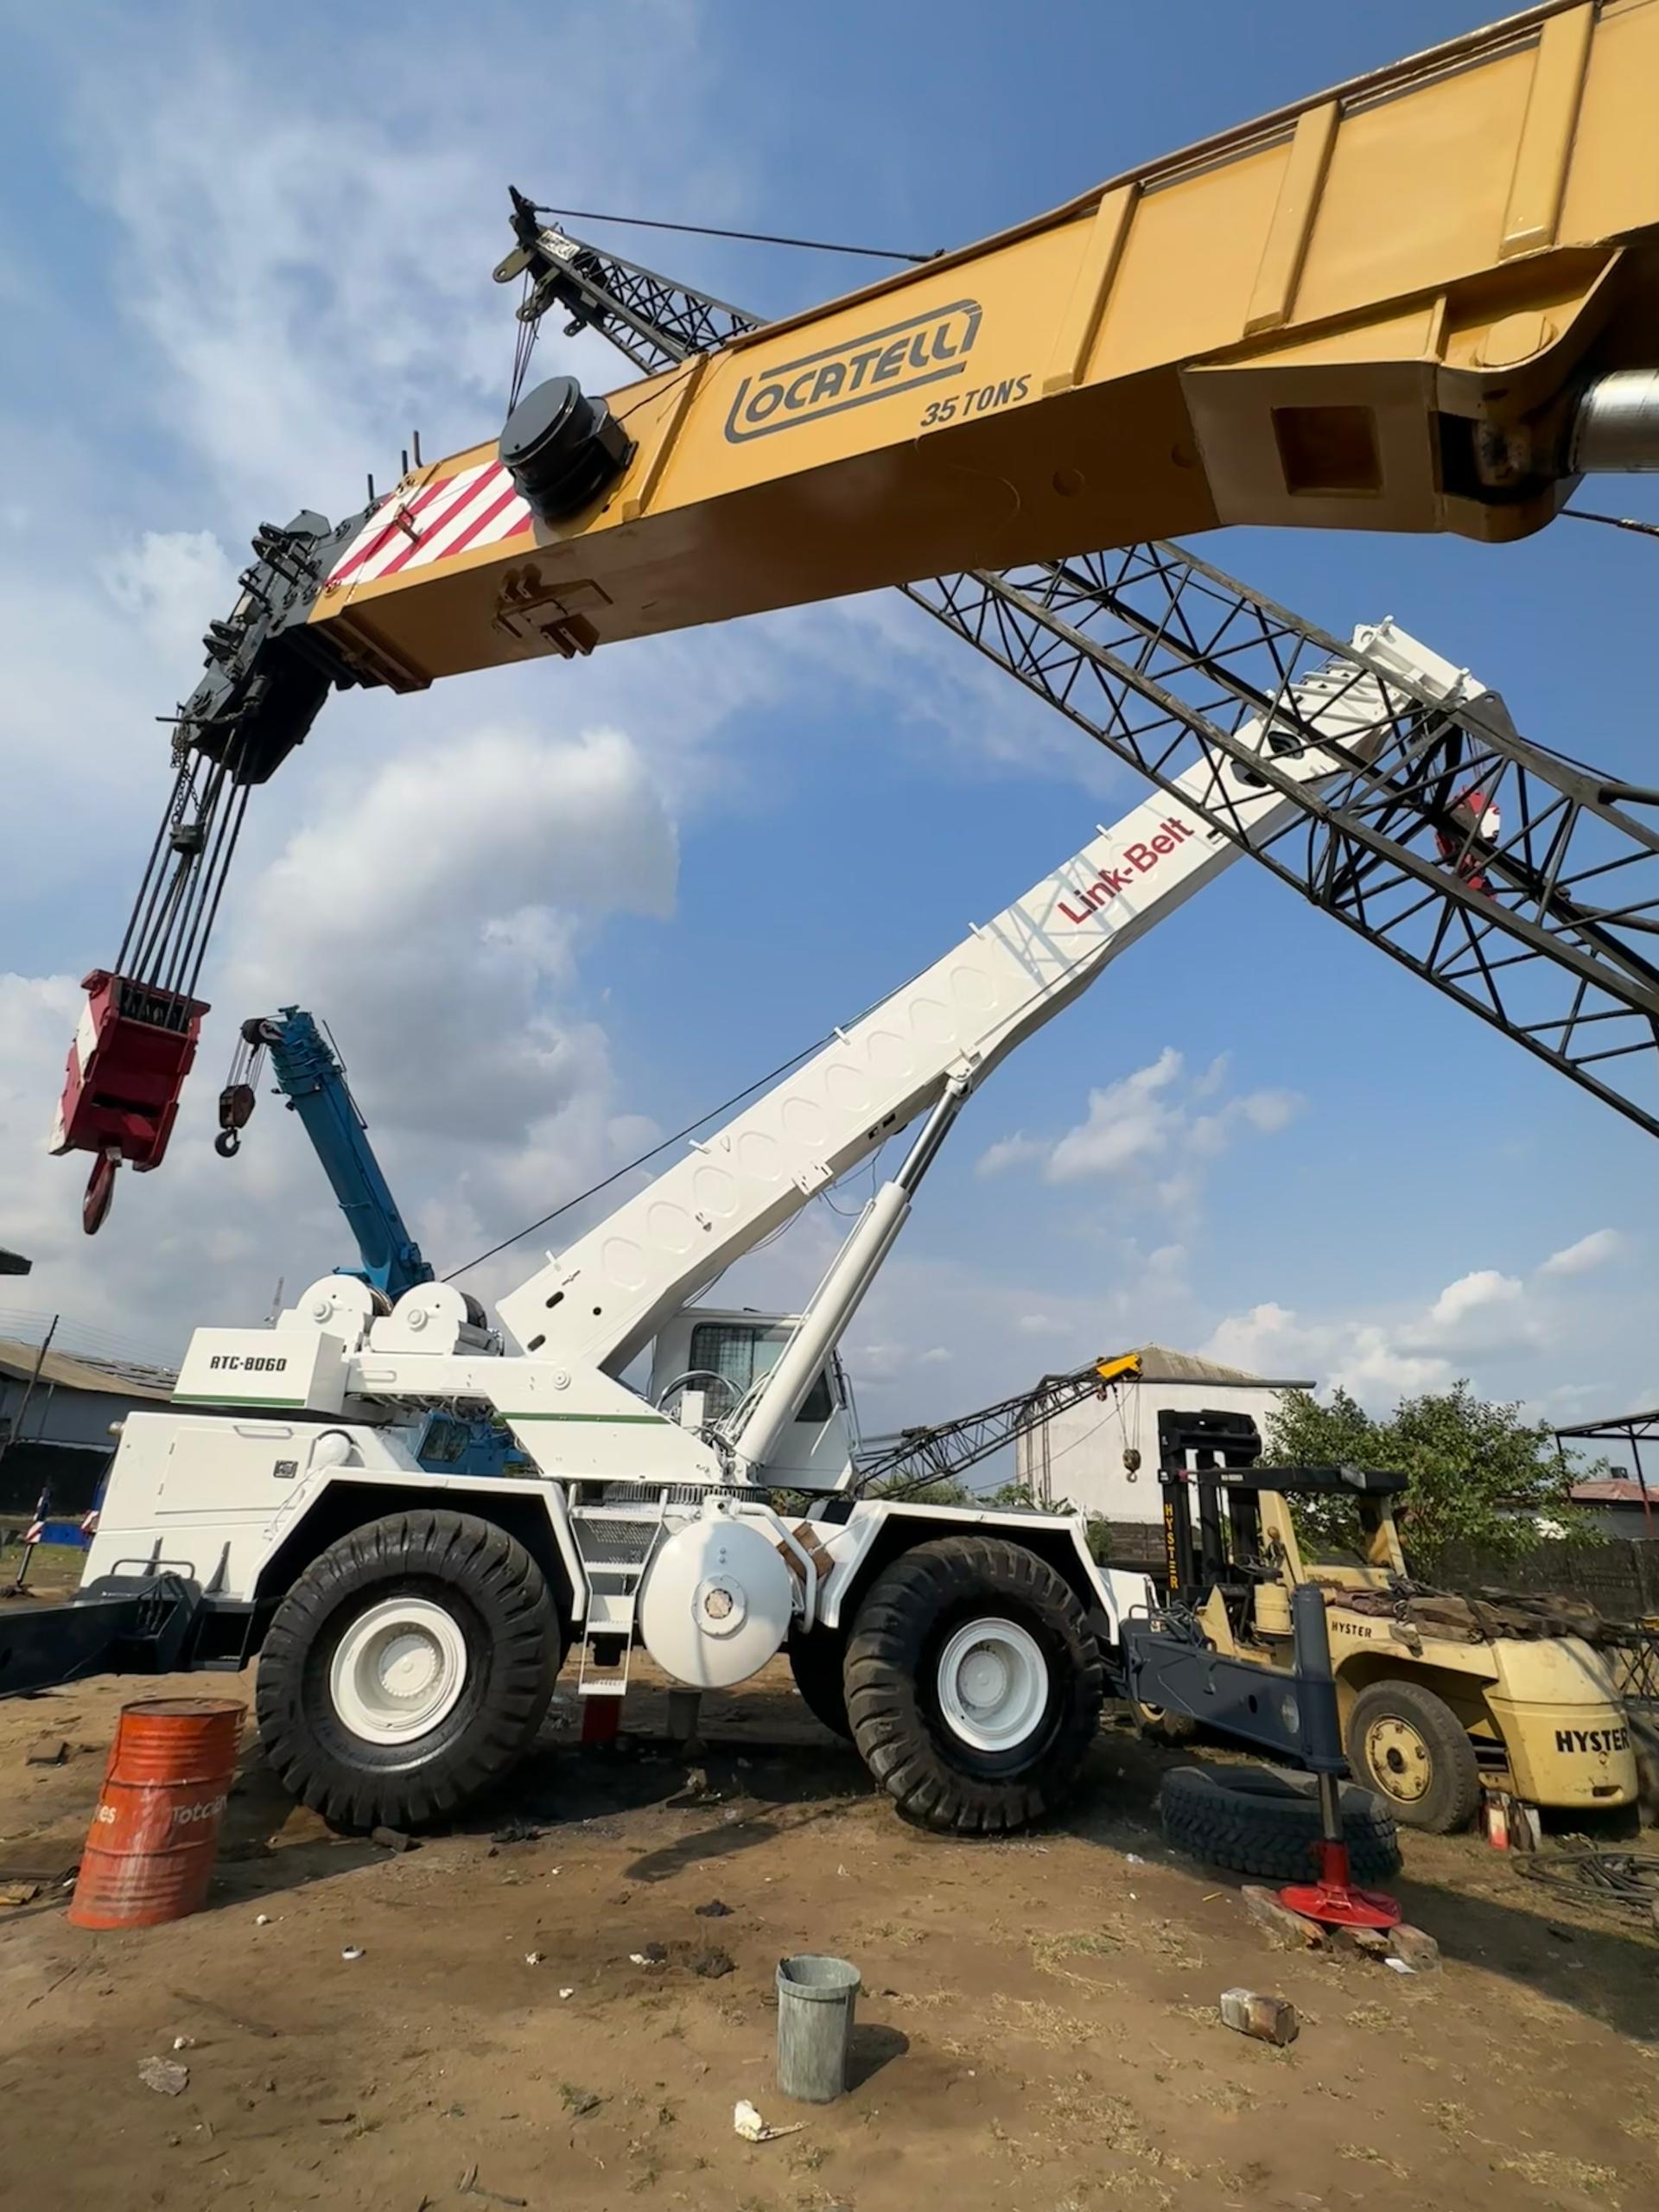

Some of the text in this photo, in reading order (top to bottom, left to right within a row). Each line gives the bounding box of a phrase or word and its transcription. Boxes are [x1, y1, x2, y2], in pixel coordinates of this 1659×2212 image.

[724, 298, 982, 444] LOCATELLI
[920, 373, 1032, 427] 35 TONS
[1057, 817, 1195, 925] Link-Belt
[1165, 1503, 1179, 1589] HYSTER
[1332, 1621, 1372, 1638] HYSTER
[1555, 1727, 1630, 1752] HYSTER
